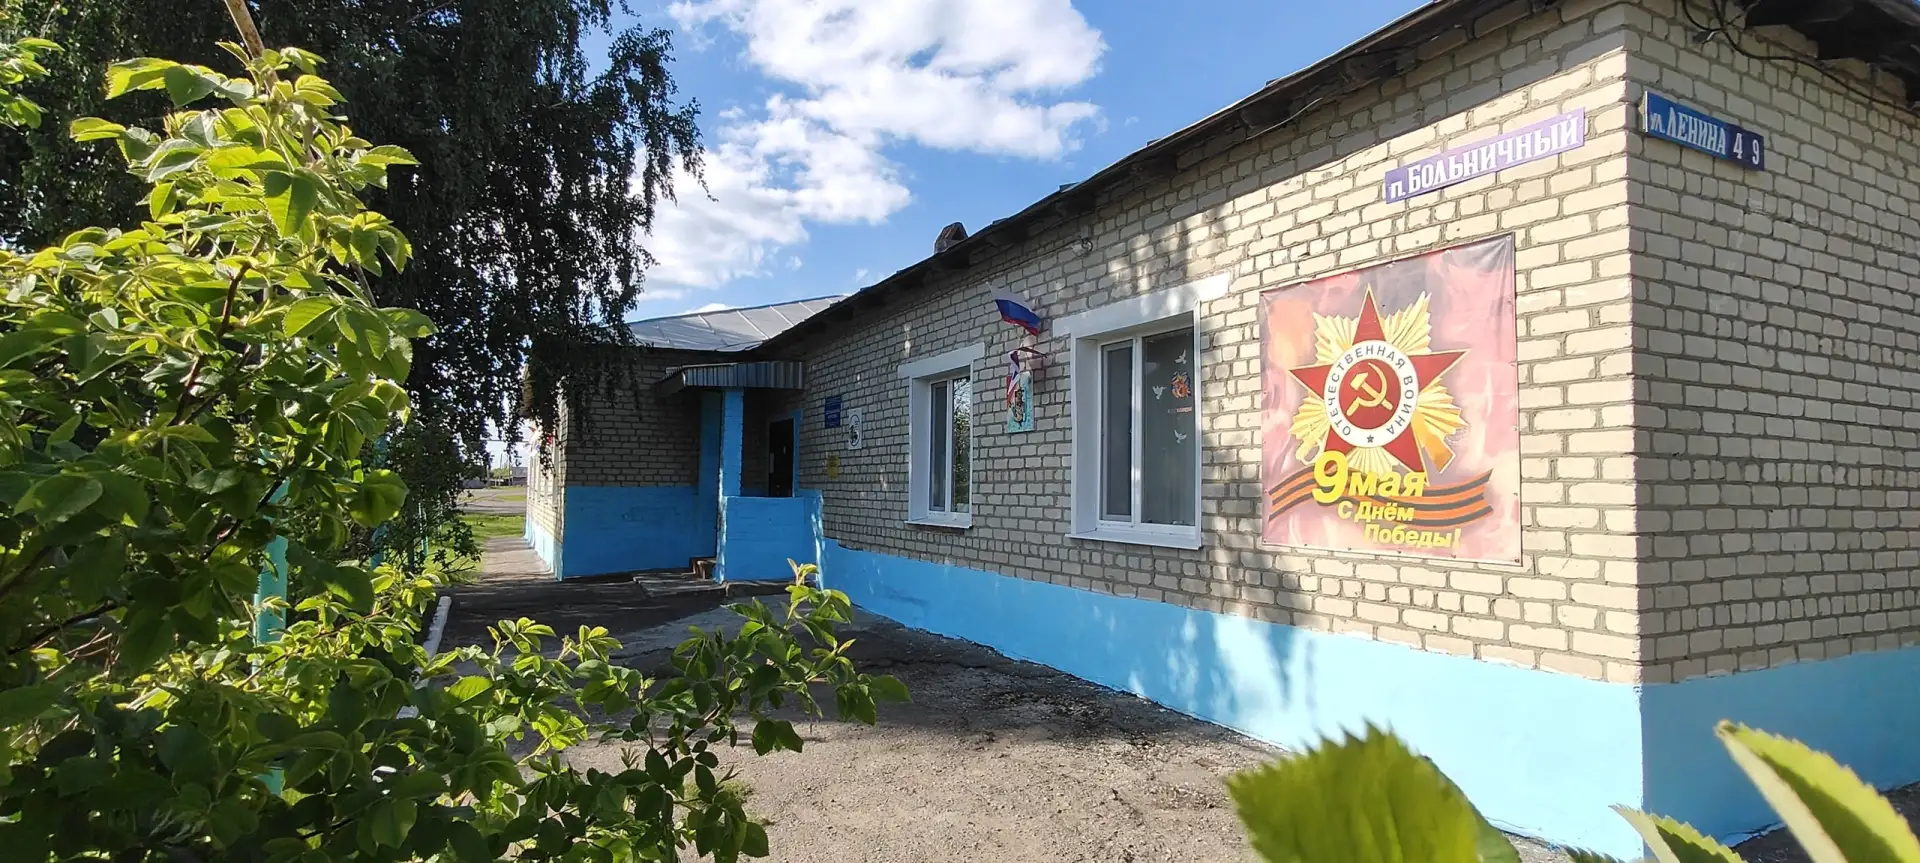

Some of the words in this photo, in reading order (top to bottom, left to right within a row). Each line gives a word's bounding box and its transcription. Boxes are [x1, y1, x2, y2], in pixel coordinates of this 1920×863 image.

[1650, 113, 1665, 133] ул.
[1666, 107, 1726, 155] ЛЕНИНА
[1389, 179, 1406, 199] п.
[1407, 113, 1579, 194] БОЛЬНИЧНЫЙ
[1327, 344, 1406, 436] ОТЕЧЕСТВЕННАЯ
[1385, 375, 1414, 434] ВОИНА
[1354, 501, 1415, 523] Днём
[1364, 523, 1461, 548] Победы!
